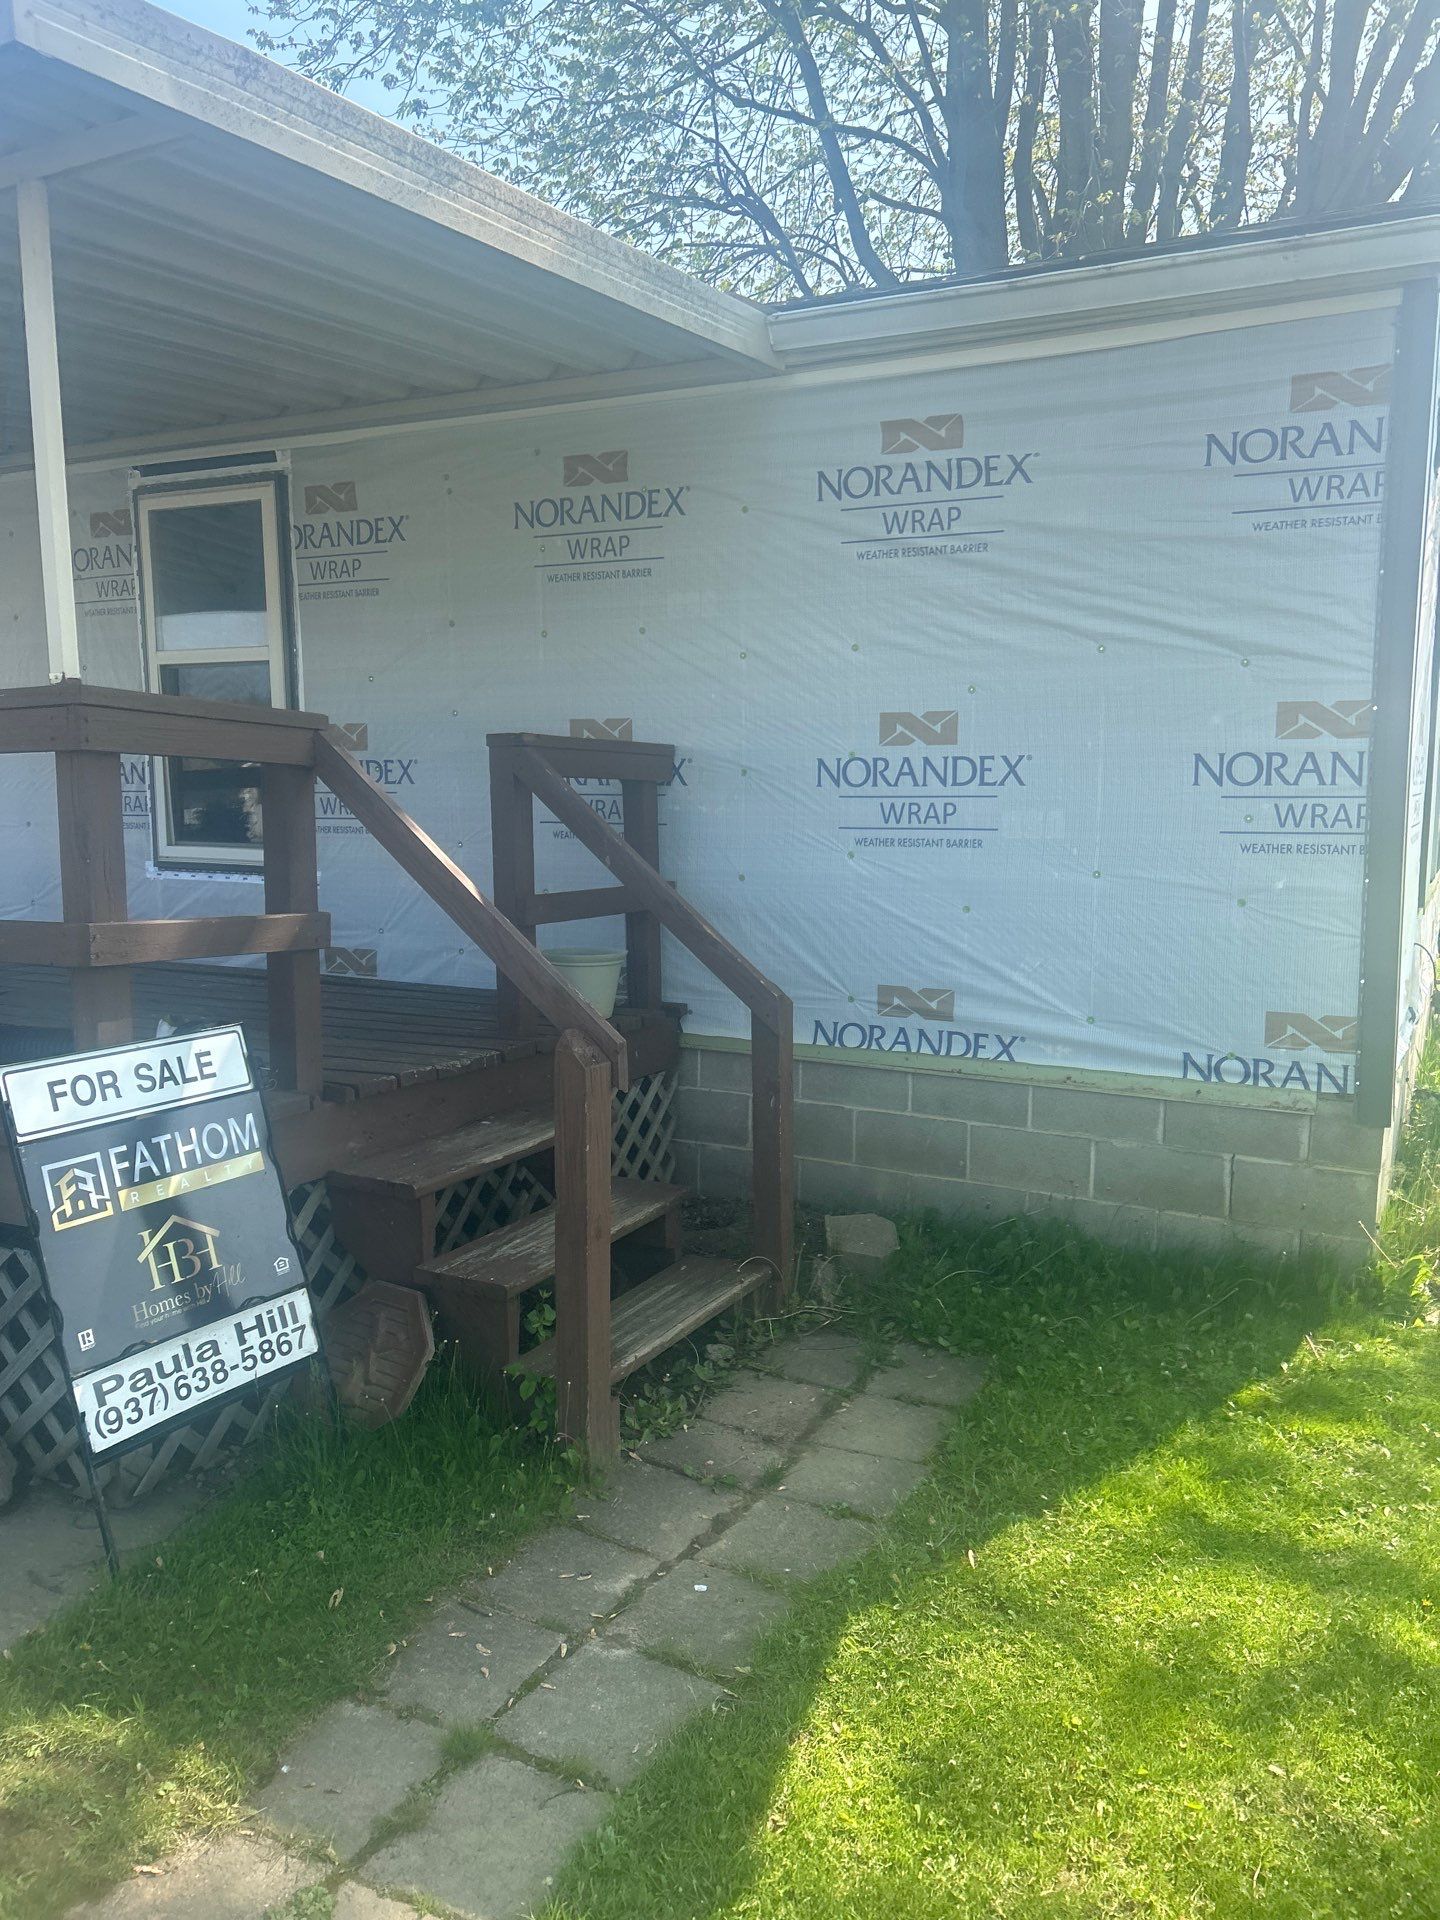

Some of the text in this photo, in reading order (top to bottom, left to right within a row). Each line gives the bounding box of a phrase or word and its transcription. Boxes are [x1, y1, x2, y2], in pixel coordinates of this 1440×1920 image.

[1203, 416, 1385, 467] NORAN
[881, 506, 962, 534] WRAP
[1252, 519, 1308, 532] WEATHER
[1310, 514, 1373, 528] RESISTANT
[566, 535, 630, 560] WRAP
[855, 542, 989, 561] WEATHER RESISTANT BARRIER
[309, 558, 362, 581] WRAP
[546, 568, 652, 583] WEATHER RESISTANT BARRIER
[299, 591, 321, 601] EATHER
[322, 589, 354, 600] RESISTANT
[1192, 751, 1366, 787] NORAN
[879, 802, 957, 825] WRAP
[854, 837, 984, 849] WEATHER RESISTANT BARRIER
[1239, 843, 1293, 855] WEATHER
[1295, 843, 1356, 856] RESISTANT
[47, 1050, 217, 1112] FOR SALE
[1182, 1051, 1350, 1096] NORAN
[108, 1112, 260, 1188] FATHOM
[130, 1159, 255, 1204] REALTY
[131, 1291, 192, 1323] Homes
[194, 1282, 214, 1304] by
[92, 1300, 300, 1409] Paula Hill
